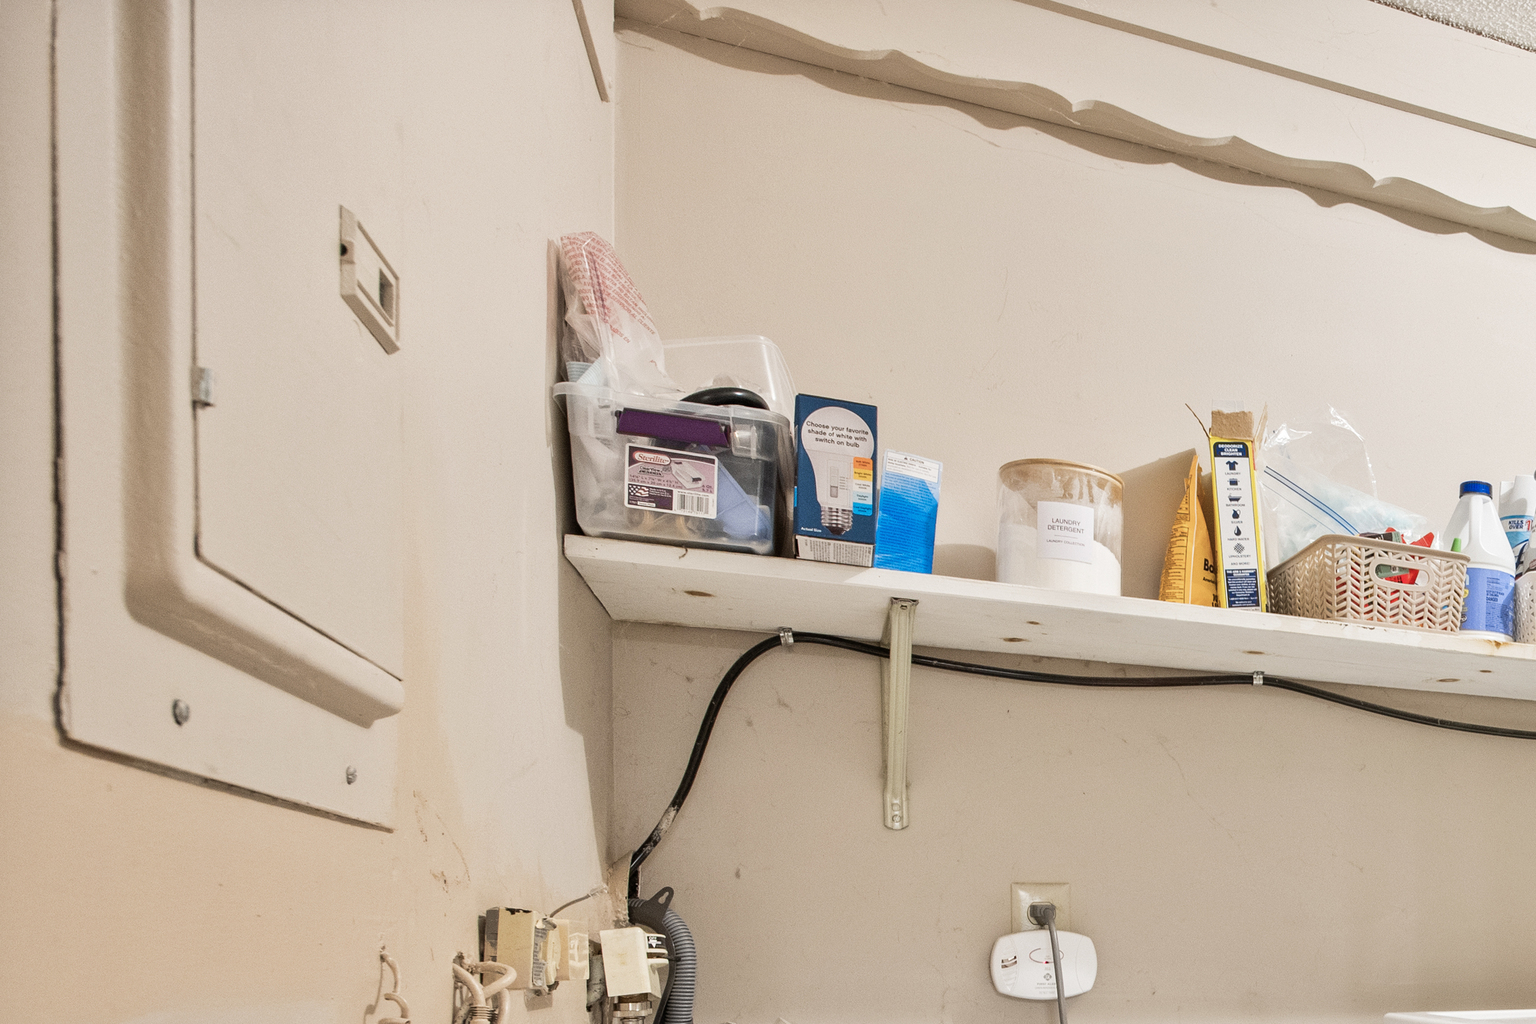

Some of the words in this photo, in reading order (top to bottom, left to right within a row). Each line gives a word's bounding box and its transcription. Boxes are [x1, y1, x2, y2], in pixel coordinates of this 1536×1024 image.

[806, 421, 830, 430] Choose
[831, 426, 845, 434] your
[846, 426, 869, 436] favorite
[807, 428, 827, 437] shade
[836, 433, 853, 441] white
[854, 435, 868, 443] with
[815, 436, 835, 445] switch
[846, 440, 860, 448] bulb
[1052, 518, 1081, 526] LAUNDRY
[1048, 525, 1084, 534] DETERGENT
